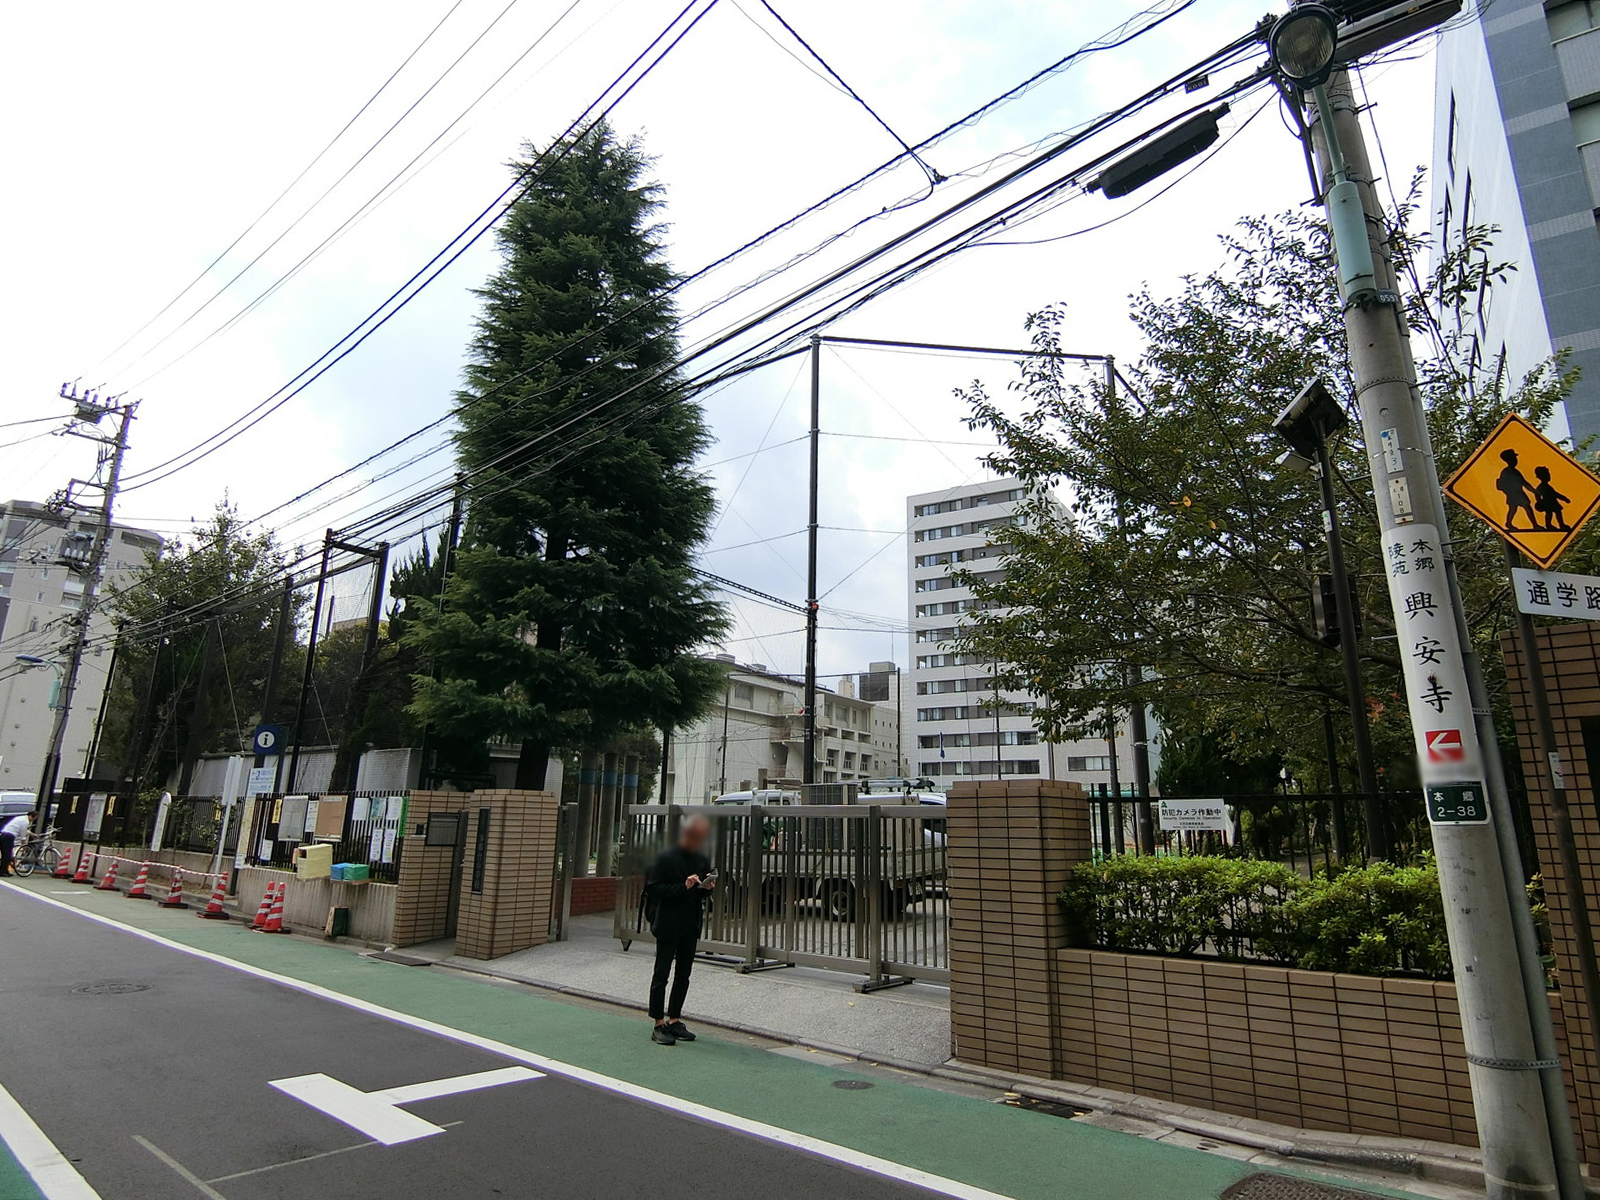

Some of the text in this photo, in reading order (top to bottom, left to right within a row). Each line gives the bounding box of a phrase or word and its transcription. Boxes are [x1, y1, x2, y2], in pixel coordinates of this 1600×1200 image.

[1526, 580, 1600, 610] 通学路
[1404, 591, 1453, 713] 興安寺
[1437, 805, 1476, 817] 2-38
